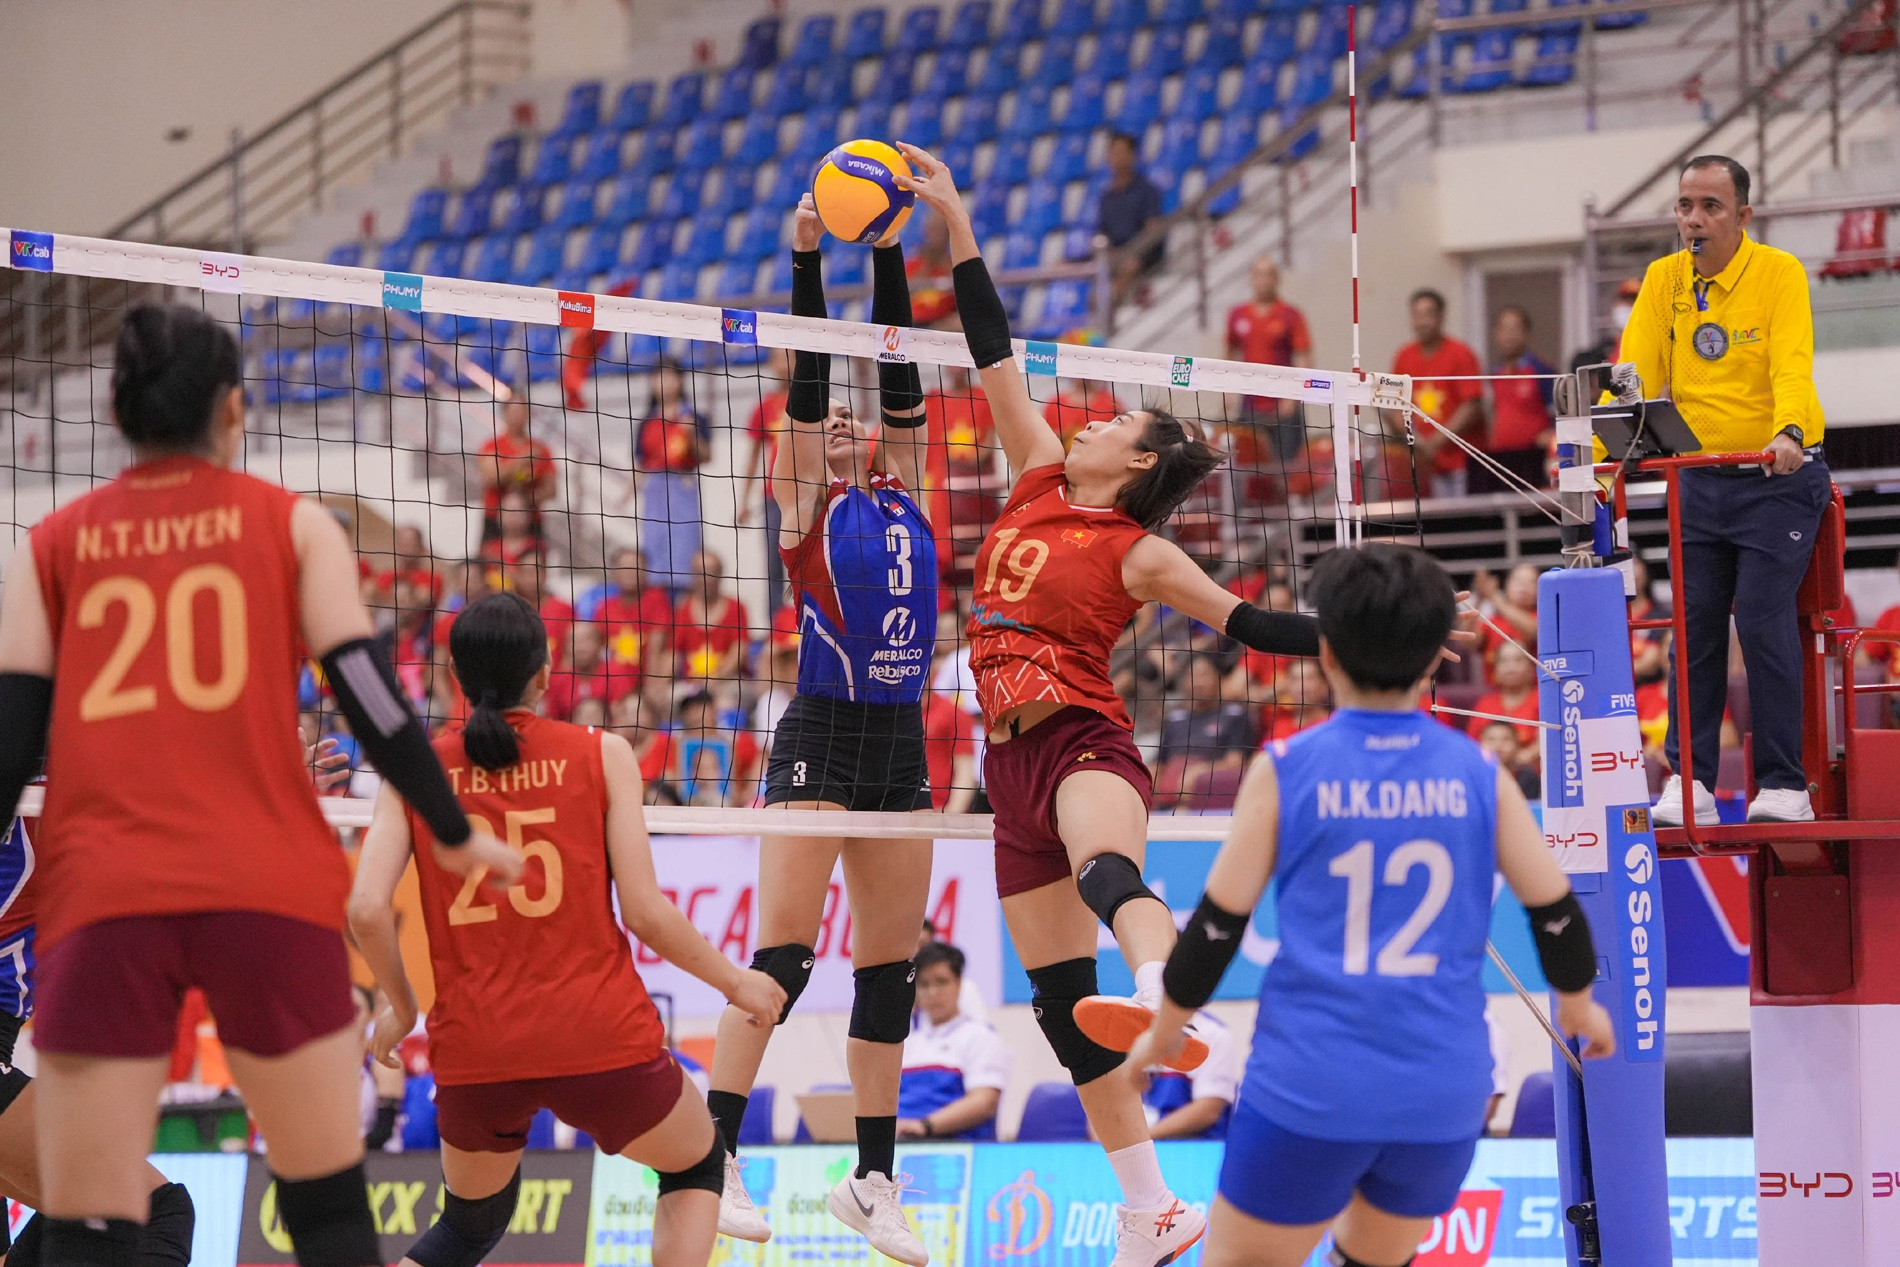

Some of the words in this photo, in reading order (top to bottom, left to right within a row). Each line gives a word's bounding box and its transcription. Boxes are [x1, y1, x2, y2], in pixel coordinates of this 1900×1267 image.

[13, 241, 50, 259] VTVcab
[202, 262, 240, 279] BYD
[560, 299, 592, 314] KukuBima
[724, 317, 753, 333] VTVcab
[879, 352, 906, 362] MERALCO
[1174, 363, 1191, 374] EURO
[1172, 373, 1190, 384] CAKE
[76, 504, 242, 562] N.T.UYEN
[885, 524, 912, 596] 3
[983, 527, 1050, 603] 19
[78, 564, 248, 720] 20
[870, 648, 923, 663] MERALCO
[1543, 657, 1567, 671] FIVB
[868, 664, 921, 683] Rebisco
[1564, 706, 1582, 797] Senoh
[1591, 750, 1646, 772] BY
[448, 759, 568, 796] T.B.THUY
[792, 760, 807, 787] 3
[1317, 778, 1468, 819] N.K.DANG
[448, 807, 564, 927] 25
[1328, 838, 1455, 977] 12
[1628, 890, 1658, 1050] Senoh
[1759, 1172, 1853, 1198] BYD
